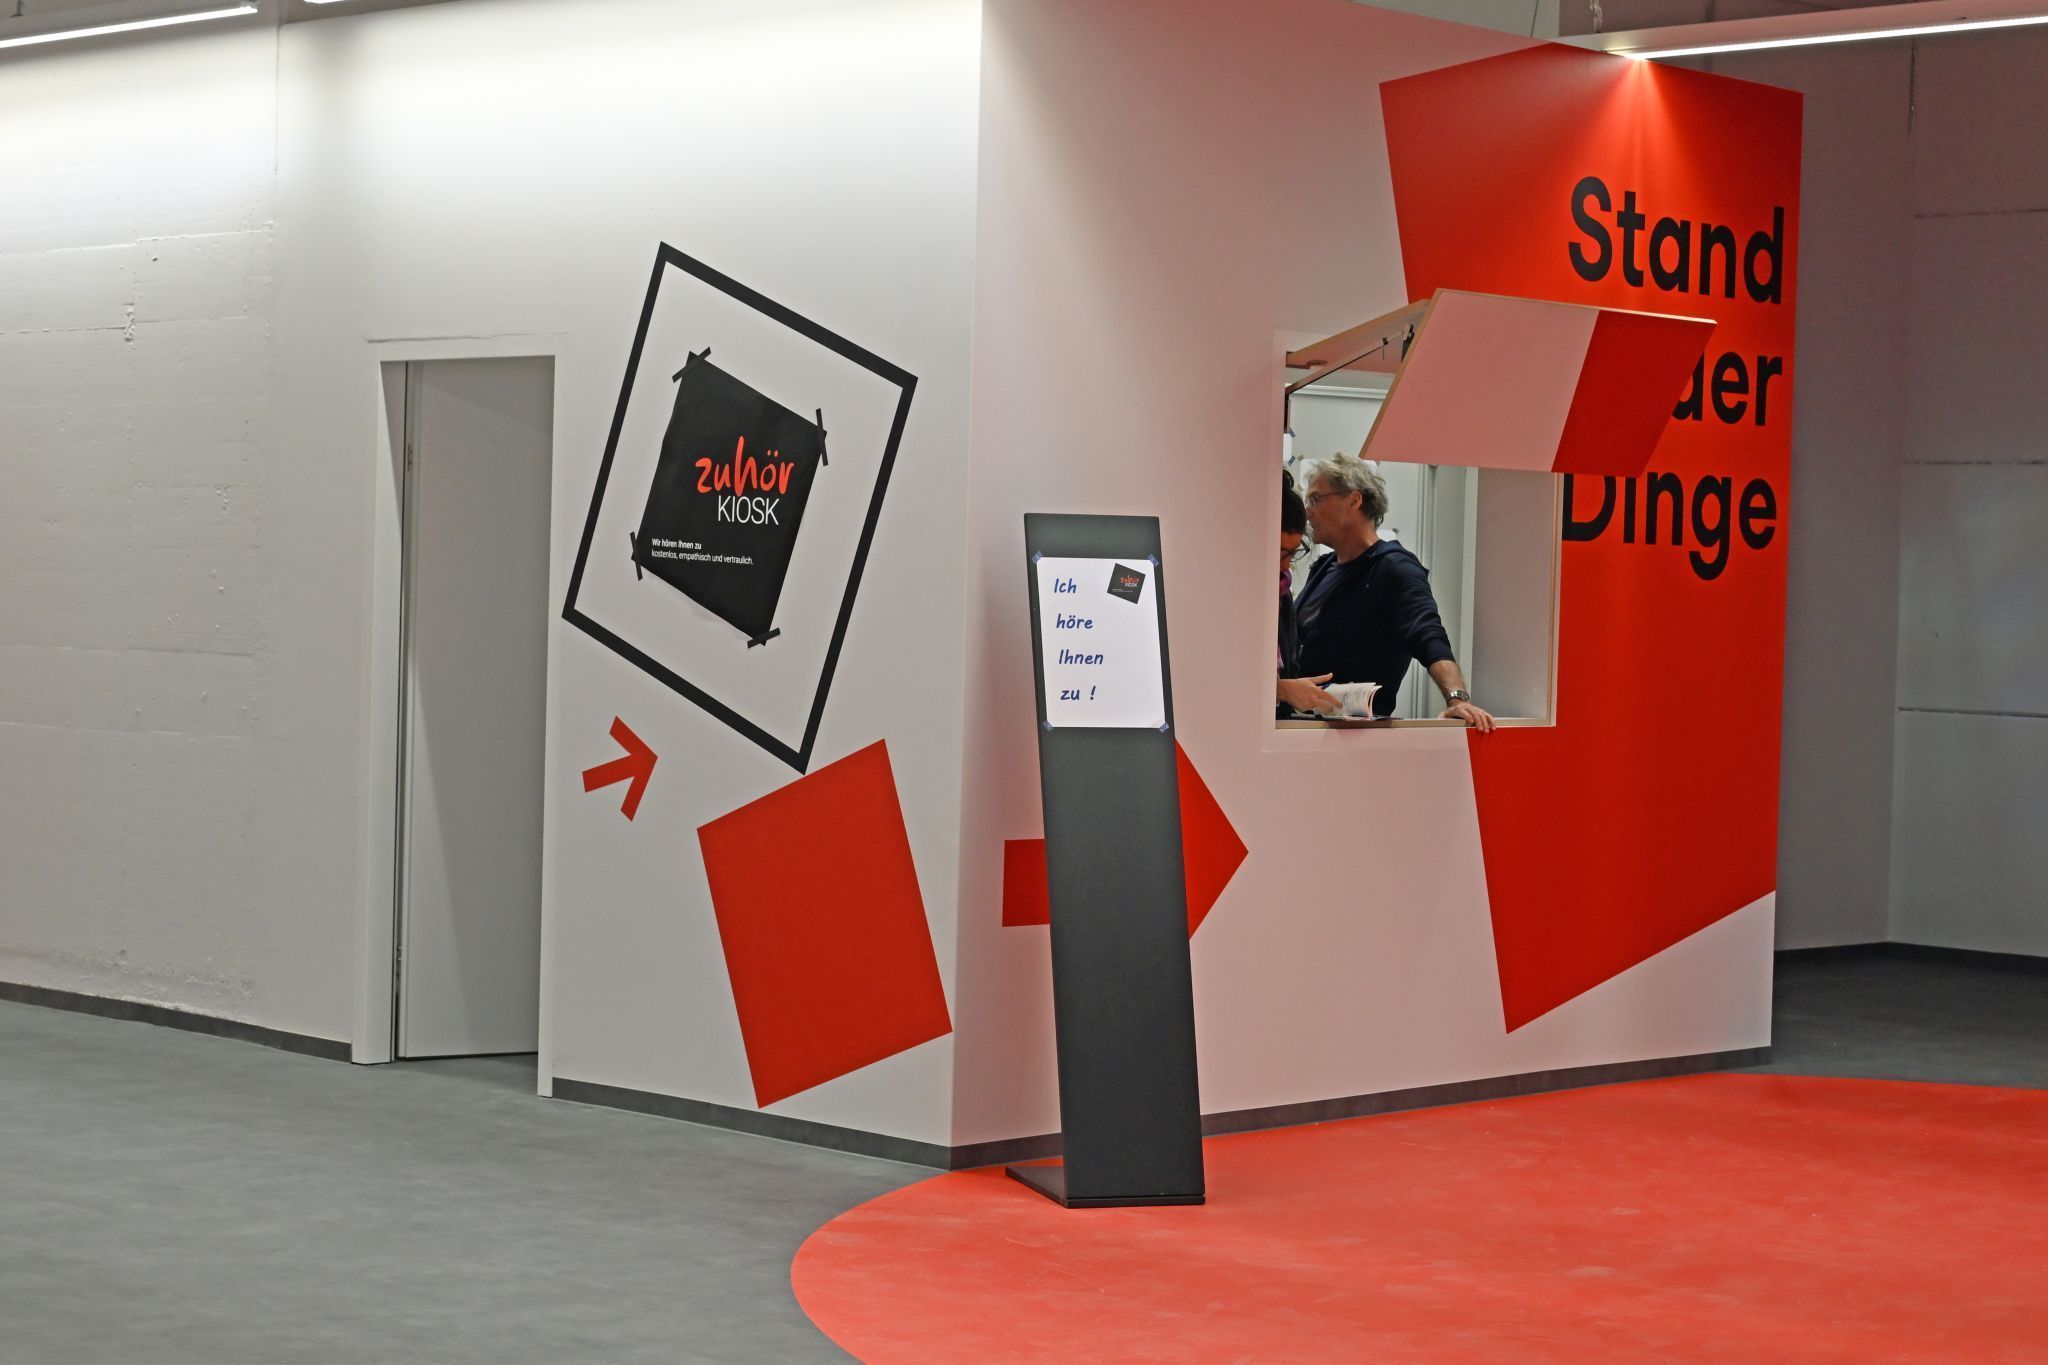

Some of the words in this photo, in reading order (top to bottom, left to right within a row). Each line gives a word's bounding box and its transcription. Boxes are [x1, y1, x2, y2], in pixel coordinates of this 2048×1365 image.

[1568, 176, 1785, 305] Stand
[695, 435, 795, 497] zuhör
[717, 495, 780, 525] KIOSK
[1562, 472, 1777, 581] Dinge
[651, 538, 661, 547] Wir
[661, 539, 677, 548] hören
[678, 540, 693, 549] Ihnen
[651, 549, 678, 559] kostenlos,
[678, 552, 711, 562] empathisch
[711, 554, 723, 563] und
[723, 556, 754, 565] vertraulich.
[1053, 578, 1077, 594] Ich
[1056, 613, 1094, 629] höre
[1058, 649, 1104, 665] Ihnen
[1060, 689, 1080, 701] zu
